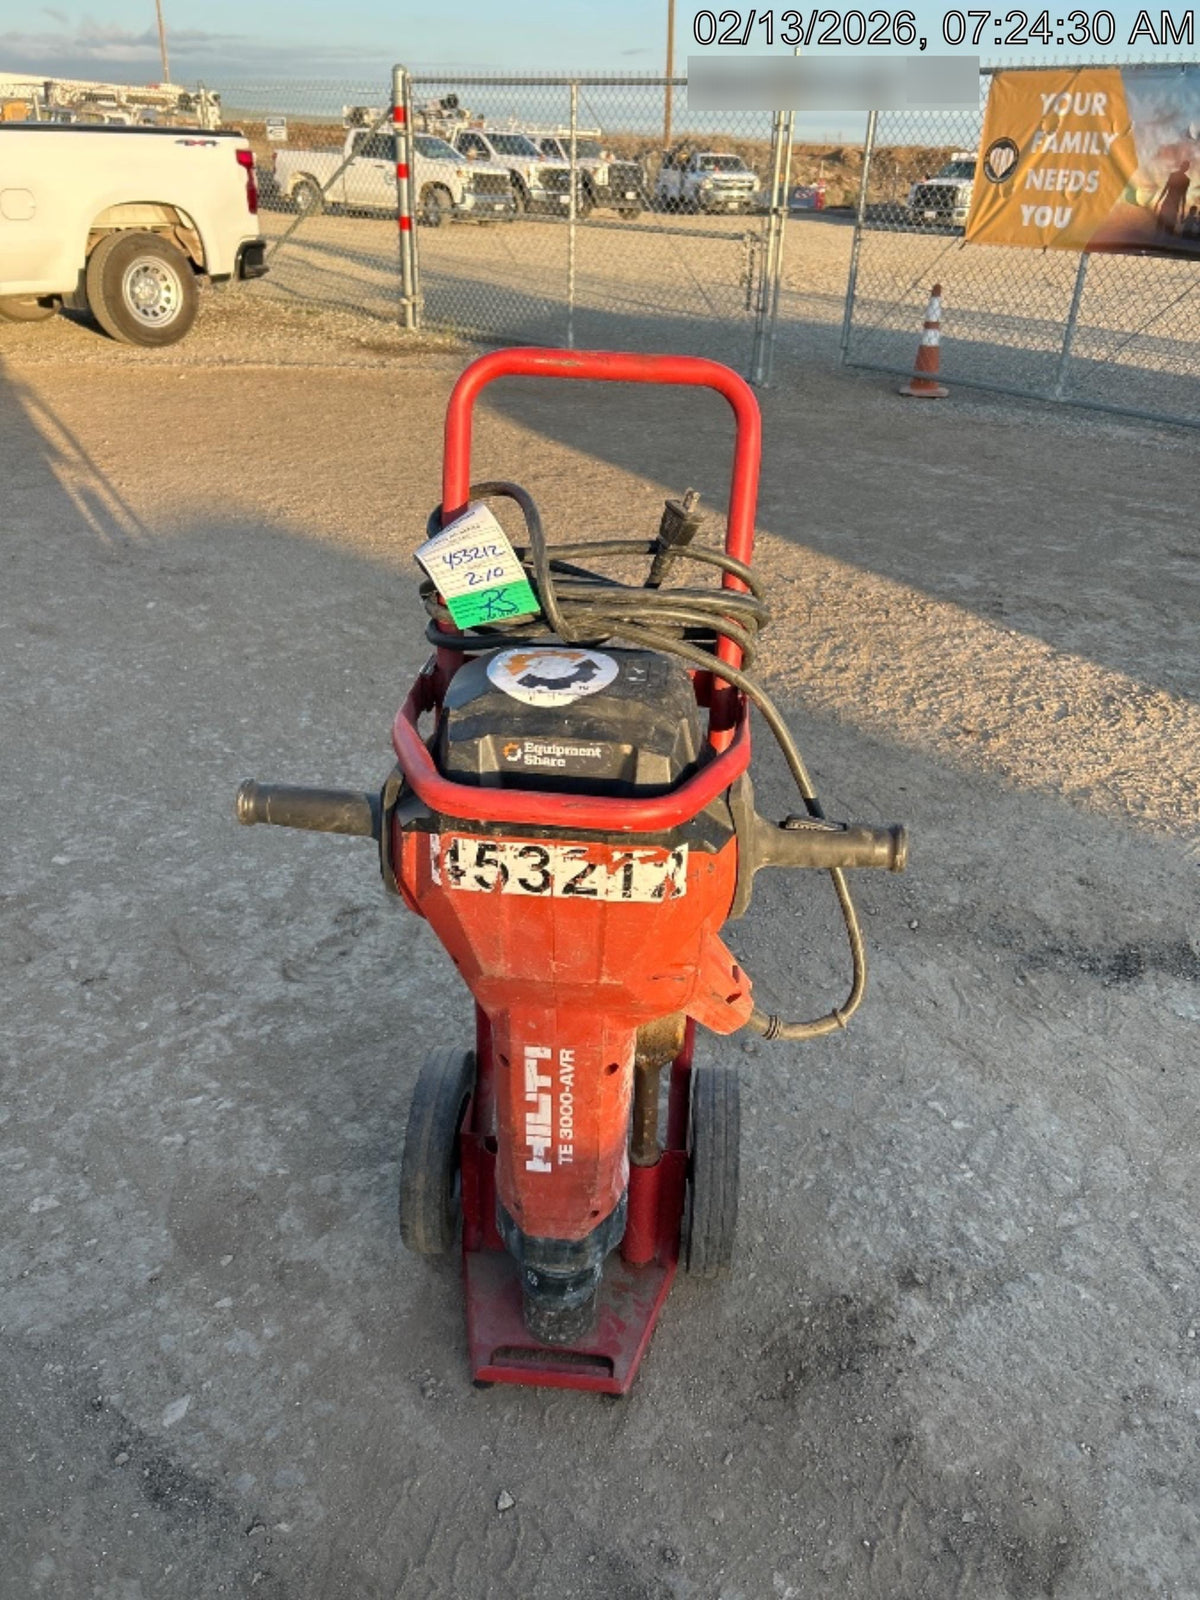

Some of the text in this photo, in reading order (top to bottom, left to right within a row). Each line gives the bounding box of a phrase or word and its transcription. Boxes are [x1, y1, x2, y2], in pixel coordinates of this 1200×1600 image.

[1040, 92, 1108, 117] YOUR
[1030, 131, 1119, 155] FAMILY
[1025, 168, 1100, 193] NEEDS
[1020, 204, 1073, 228] YOU
[442, 545, 505, 570] 453212
[523, 741, 602, 759] Equipment
[523, 754, 566, 767] Share
[524, 1046, 552, 1173] HILTI
[558, 1048, 575, 1165] TE 3000-AVR
